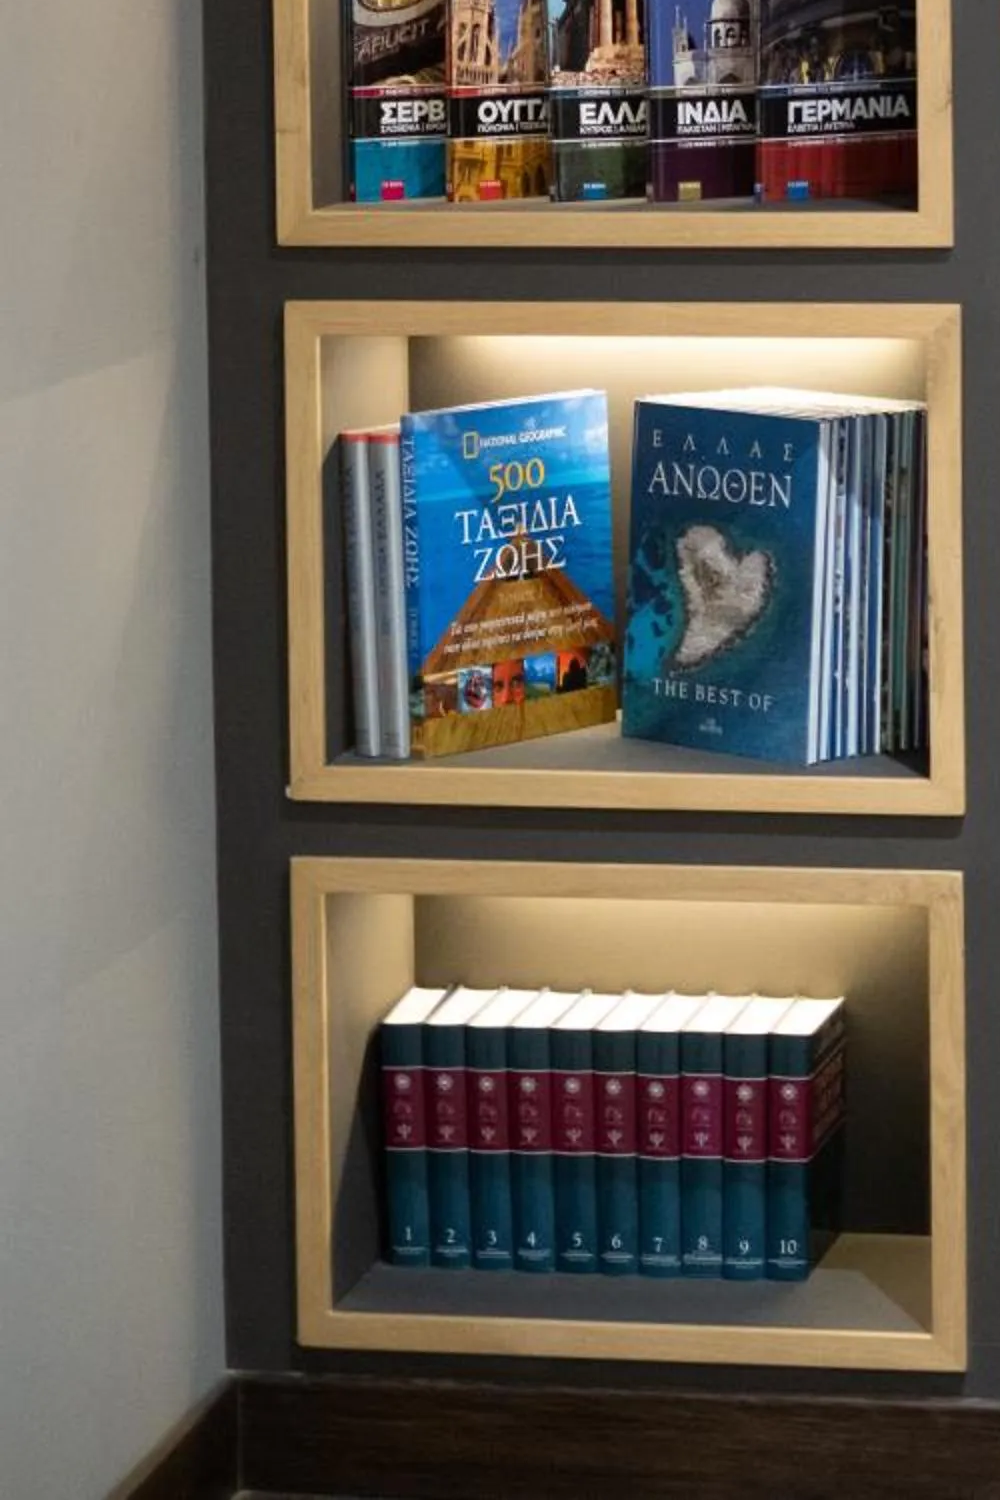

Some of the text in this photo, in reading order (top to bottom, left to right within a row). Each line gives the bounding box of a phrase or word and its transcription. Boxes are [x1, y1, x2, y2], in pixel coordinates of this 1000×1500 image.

[380, 100, 445, 124] ΣΕΡΒ
[677, 100, 747, 125] ΙΝΔΙΑ
[788, 95, 910, 123] ΓΕΡΜΑΝΙΑ
[402, 436, 417, 521] ΤΑΞΙΔΙΑ
[490, 458, 545, 503] 500
[647, 460, 792, 509] ΑΝΩΘΕΝ
[454, 494, 582, 545] ΤΑΞΙΔΙΑ
[405, 524, 420, 588] ΖΩΗΣ
[474, 535, 566, 582] ΖΩΗΣ
[652, 677, 775, 712] THE BEST OF
[405, 1226, 412, 1241] 1
[447, 1228, 456, 1243] 2
[488, 1230, 498, 1245] 3
[527, 1231, 537, 1247] 4
[572, 1232, 583, 1247] 5
[611, 1233, 622, 1249] 6
[699, 1235, 709, 1250] 8
[653, 1236, 664, 1252] 7
[739, 1237, 750, 1254] 9
[780, 1239, 798, 1254] 10
